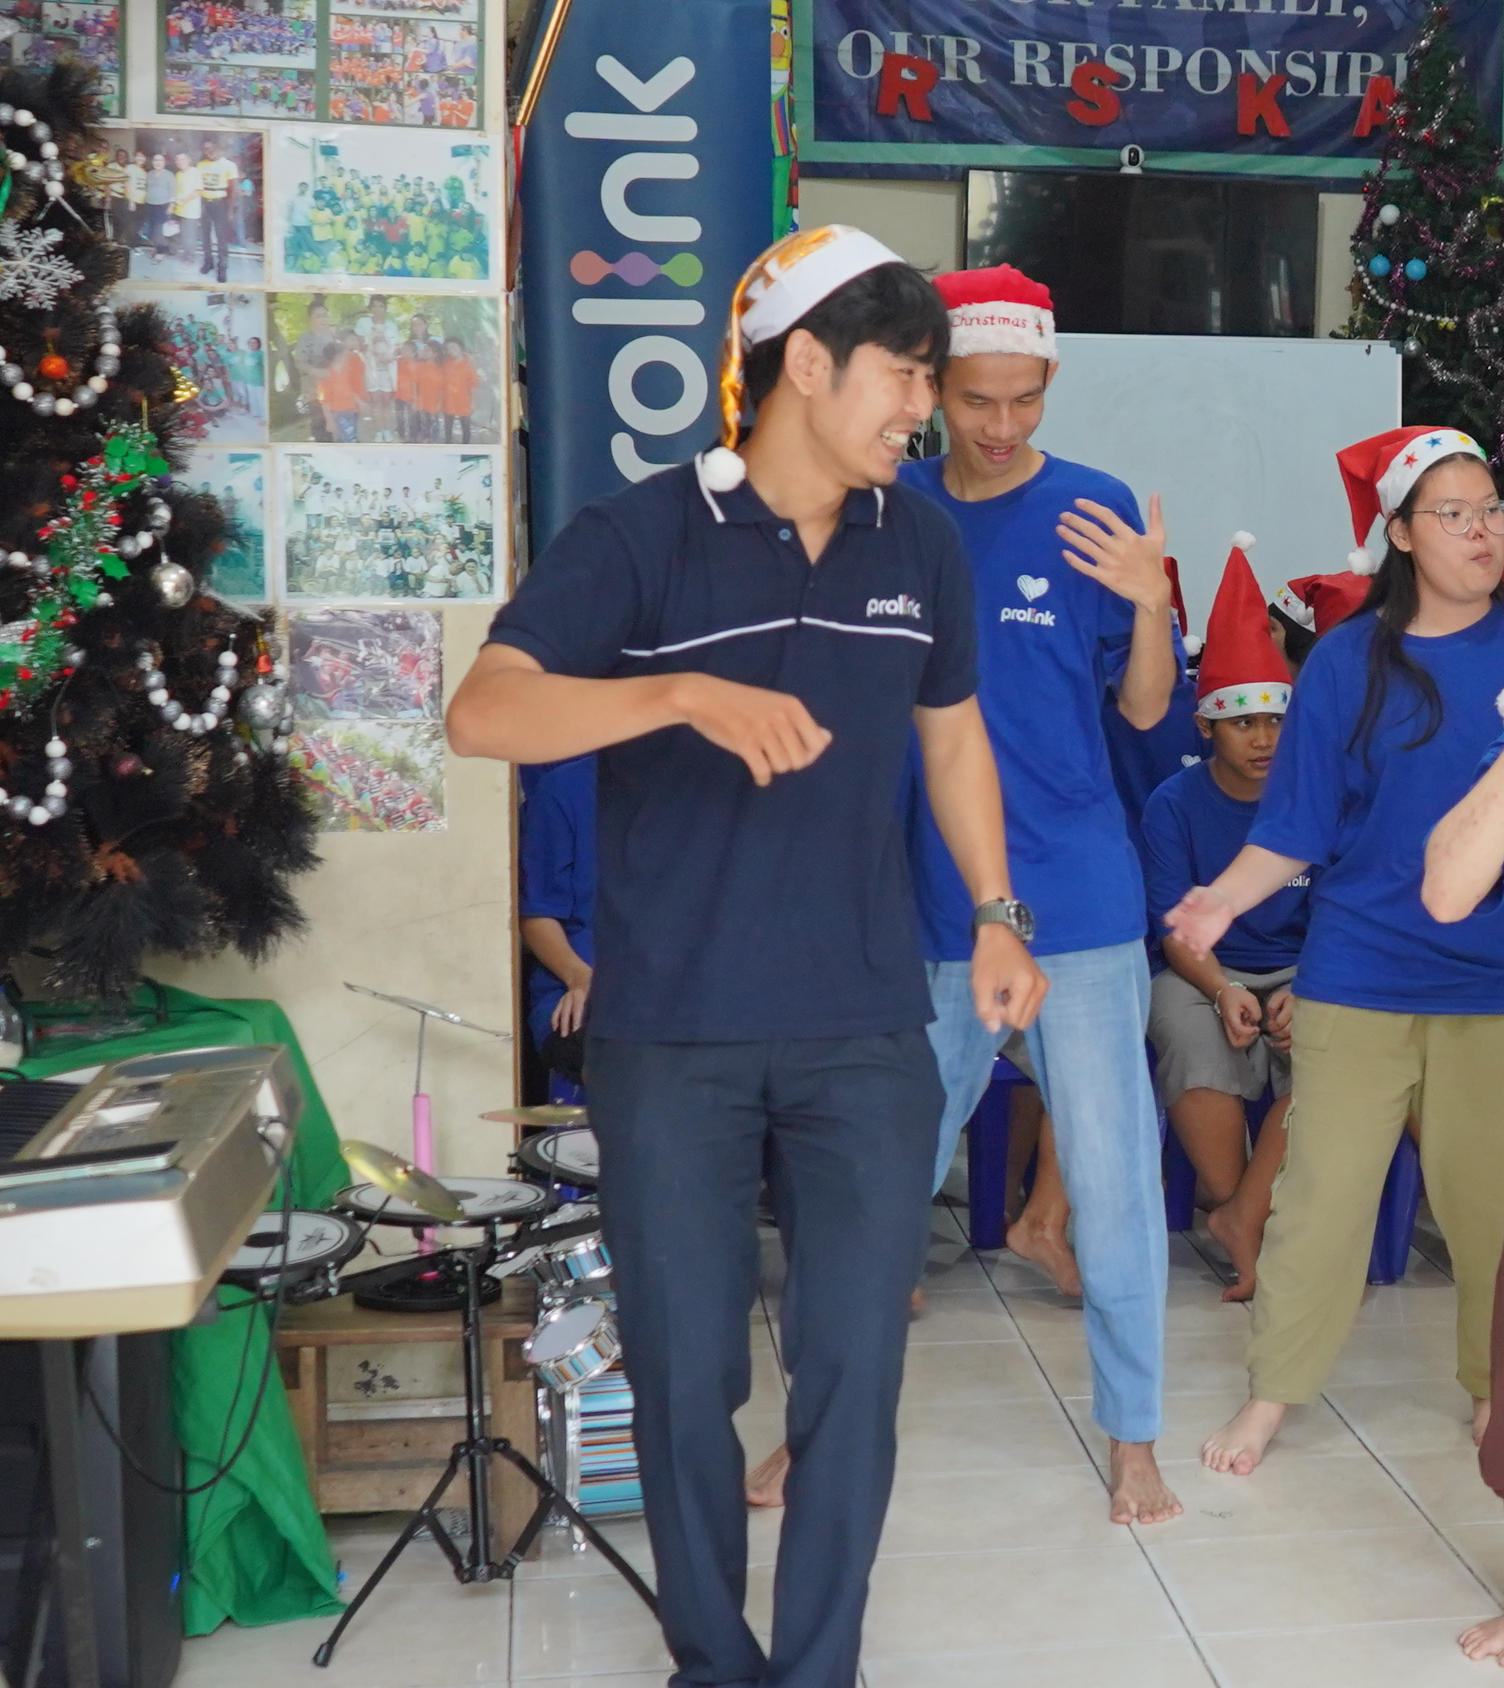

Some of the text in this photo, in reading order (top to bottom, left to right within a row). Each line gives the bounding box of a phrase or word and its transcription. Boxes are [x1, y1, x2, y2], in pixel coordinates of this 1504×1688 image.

[876, 52, 1397, 137] R S K A
[564, 54, 709, 485] rolink
[950, 312, 1028, 329] Christmas
[866, 594, 921, 619] prolink
[1000, 607, 1056, 626] prolink
